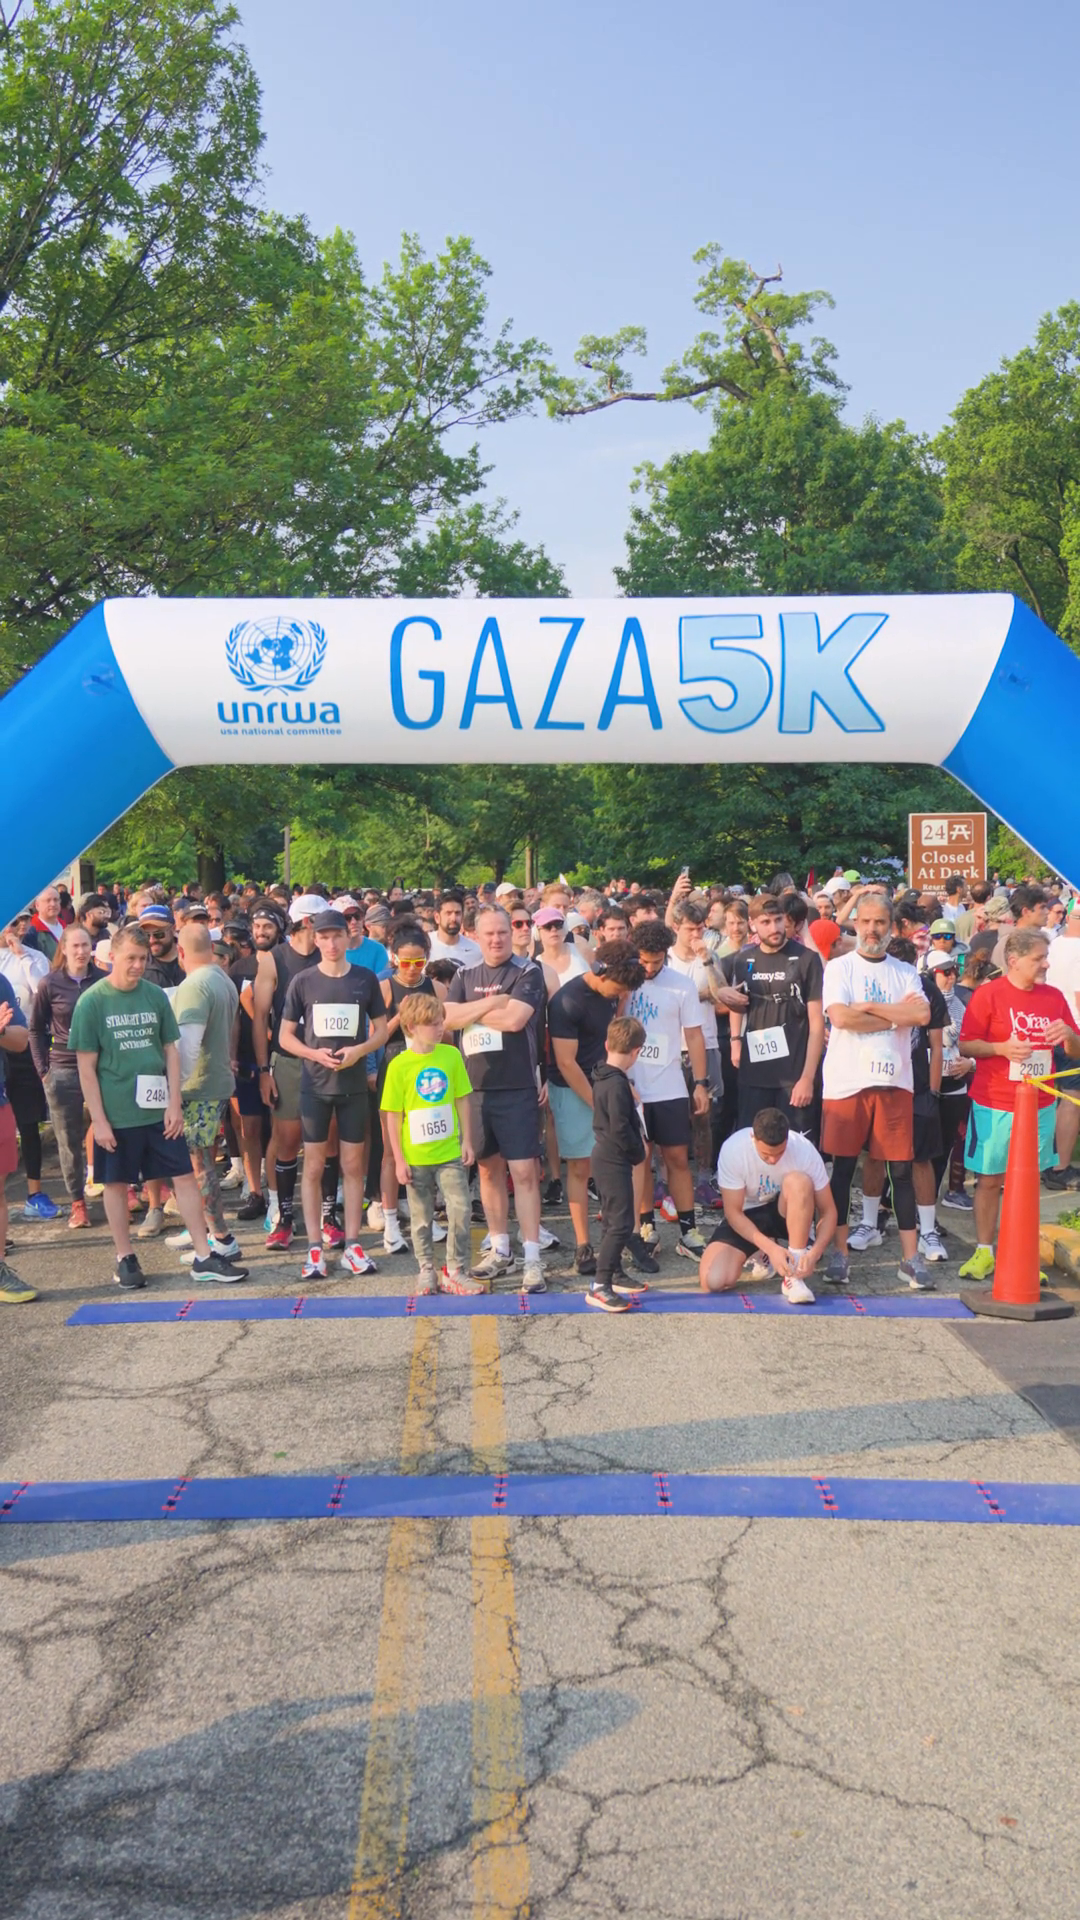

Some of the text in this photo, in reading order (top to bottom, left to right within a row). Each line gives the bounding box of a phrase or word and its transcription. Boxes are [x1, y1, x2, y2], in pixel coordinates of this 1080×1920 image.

[389, 612, 890, 735] GAZA 5K
[217, 701, 341, 724] unrwa
[220, 727, 342, 736] usa national committee
[924, 824, 946, 840] 24
[921, 850, 975, 864] Closed
[917, 866, 979, 879] At Dark
[105, 1014, 139, 1028] STRAIGHT
[324, 1017, 349, 1030] 1202
[469, 1032, 492, 1048] 1653
[639, 1045, 660, 1059] 220
[754, 1040, 778, 1056] 1219
[870, 1061, 895, 1076] 1143
[1019, 1062, 1045, 1077] 2203
[146, 1089, 166, 1102] 2484
[421, 1119, 447, 1136] 1655
